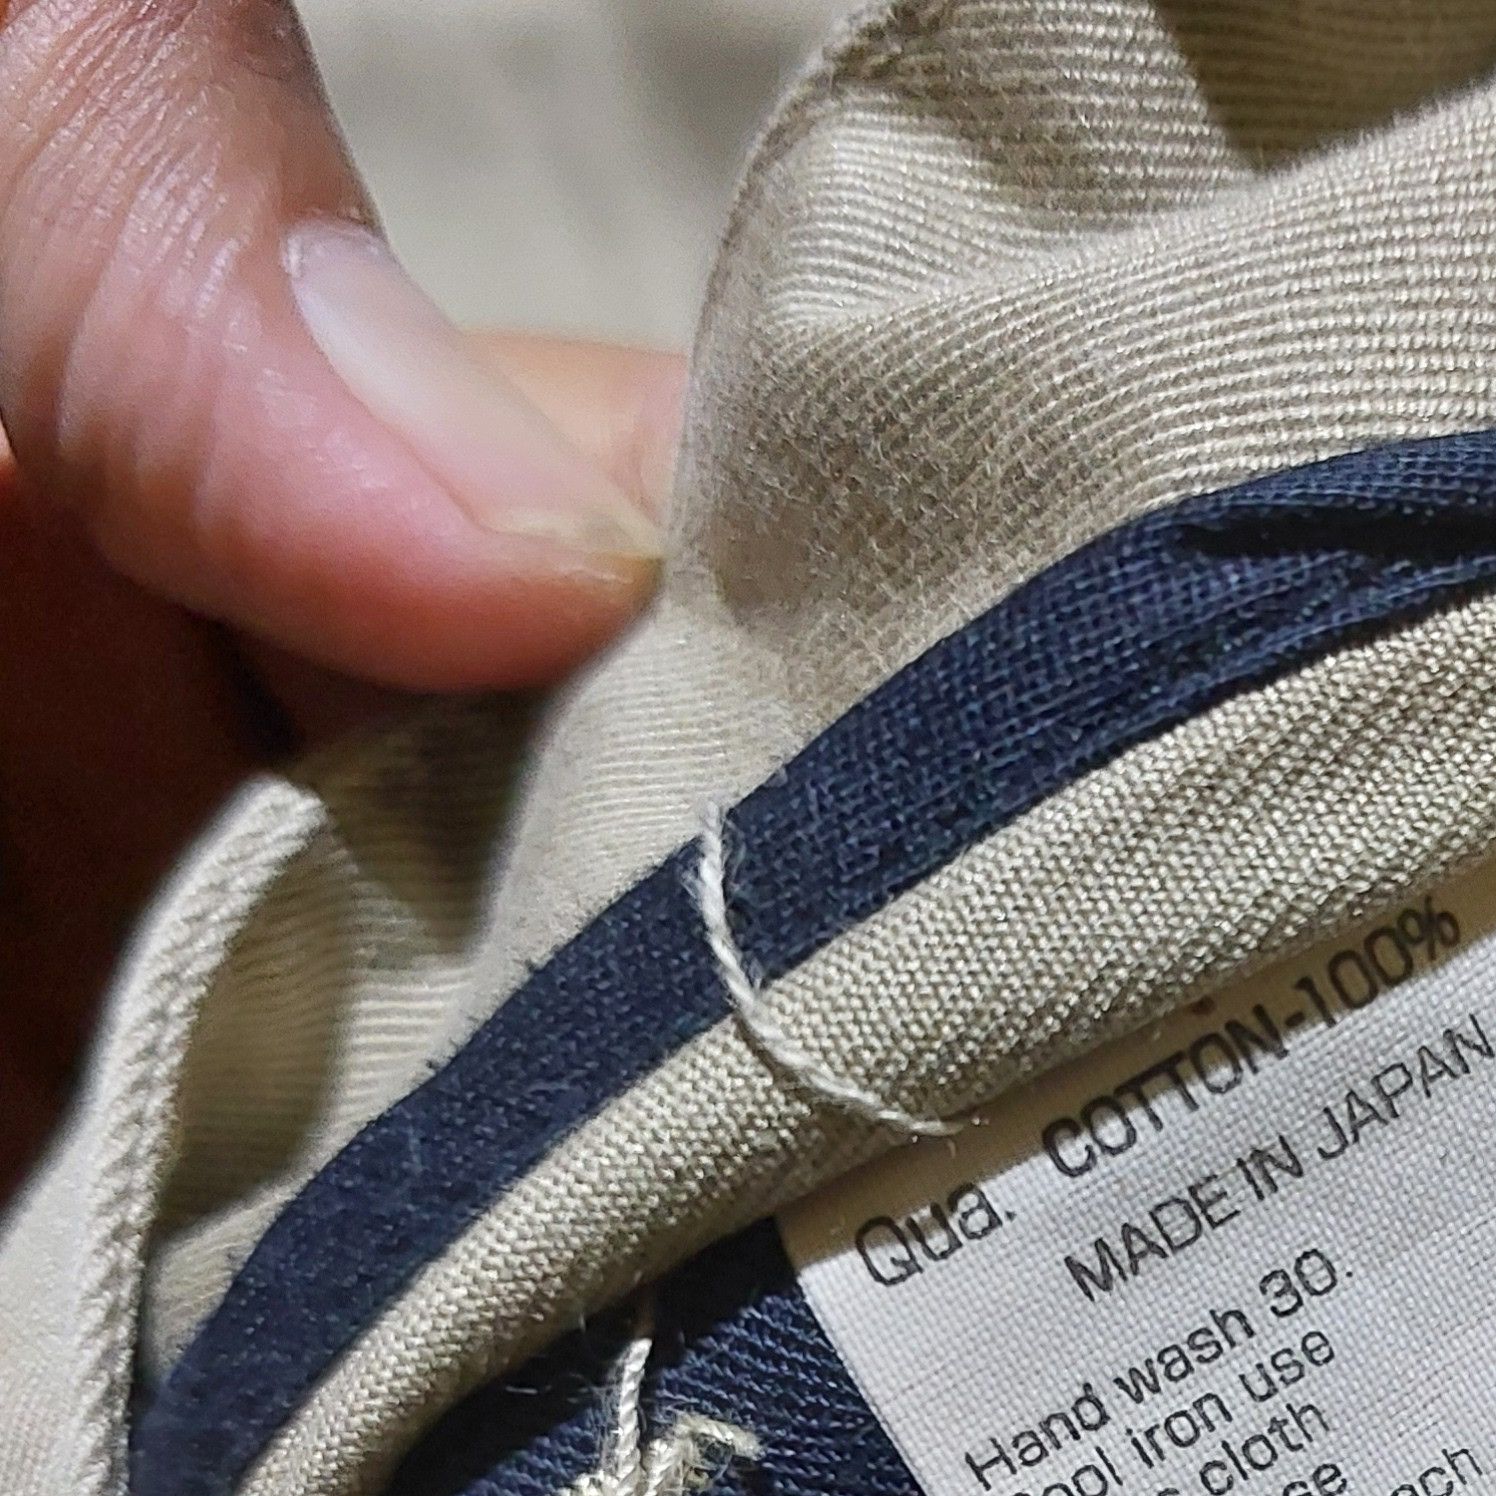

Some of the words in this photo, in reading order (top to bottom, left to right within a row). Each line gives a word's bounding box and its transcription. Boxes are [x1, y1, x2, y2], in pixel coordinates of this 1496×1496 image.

[854, 1185, 1016, 1287] Qua.
[1039, 896, 1459, 1178] COTTON-100%
[1064, 1174, 1241, 1302] MADE
[1236, 1135, 1301, 1201] IN
[1317, 1013, 1494, 1161] JAPAN
[965, 1383, 1111, 1491] Hand
[1114, 1307, 1254, 1404] wash
[1125, 1392, 1232, 1468] iron
[1240, 1331, 1335, 1402] use
[1200, 1402, 1330, 1496] cloth
